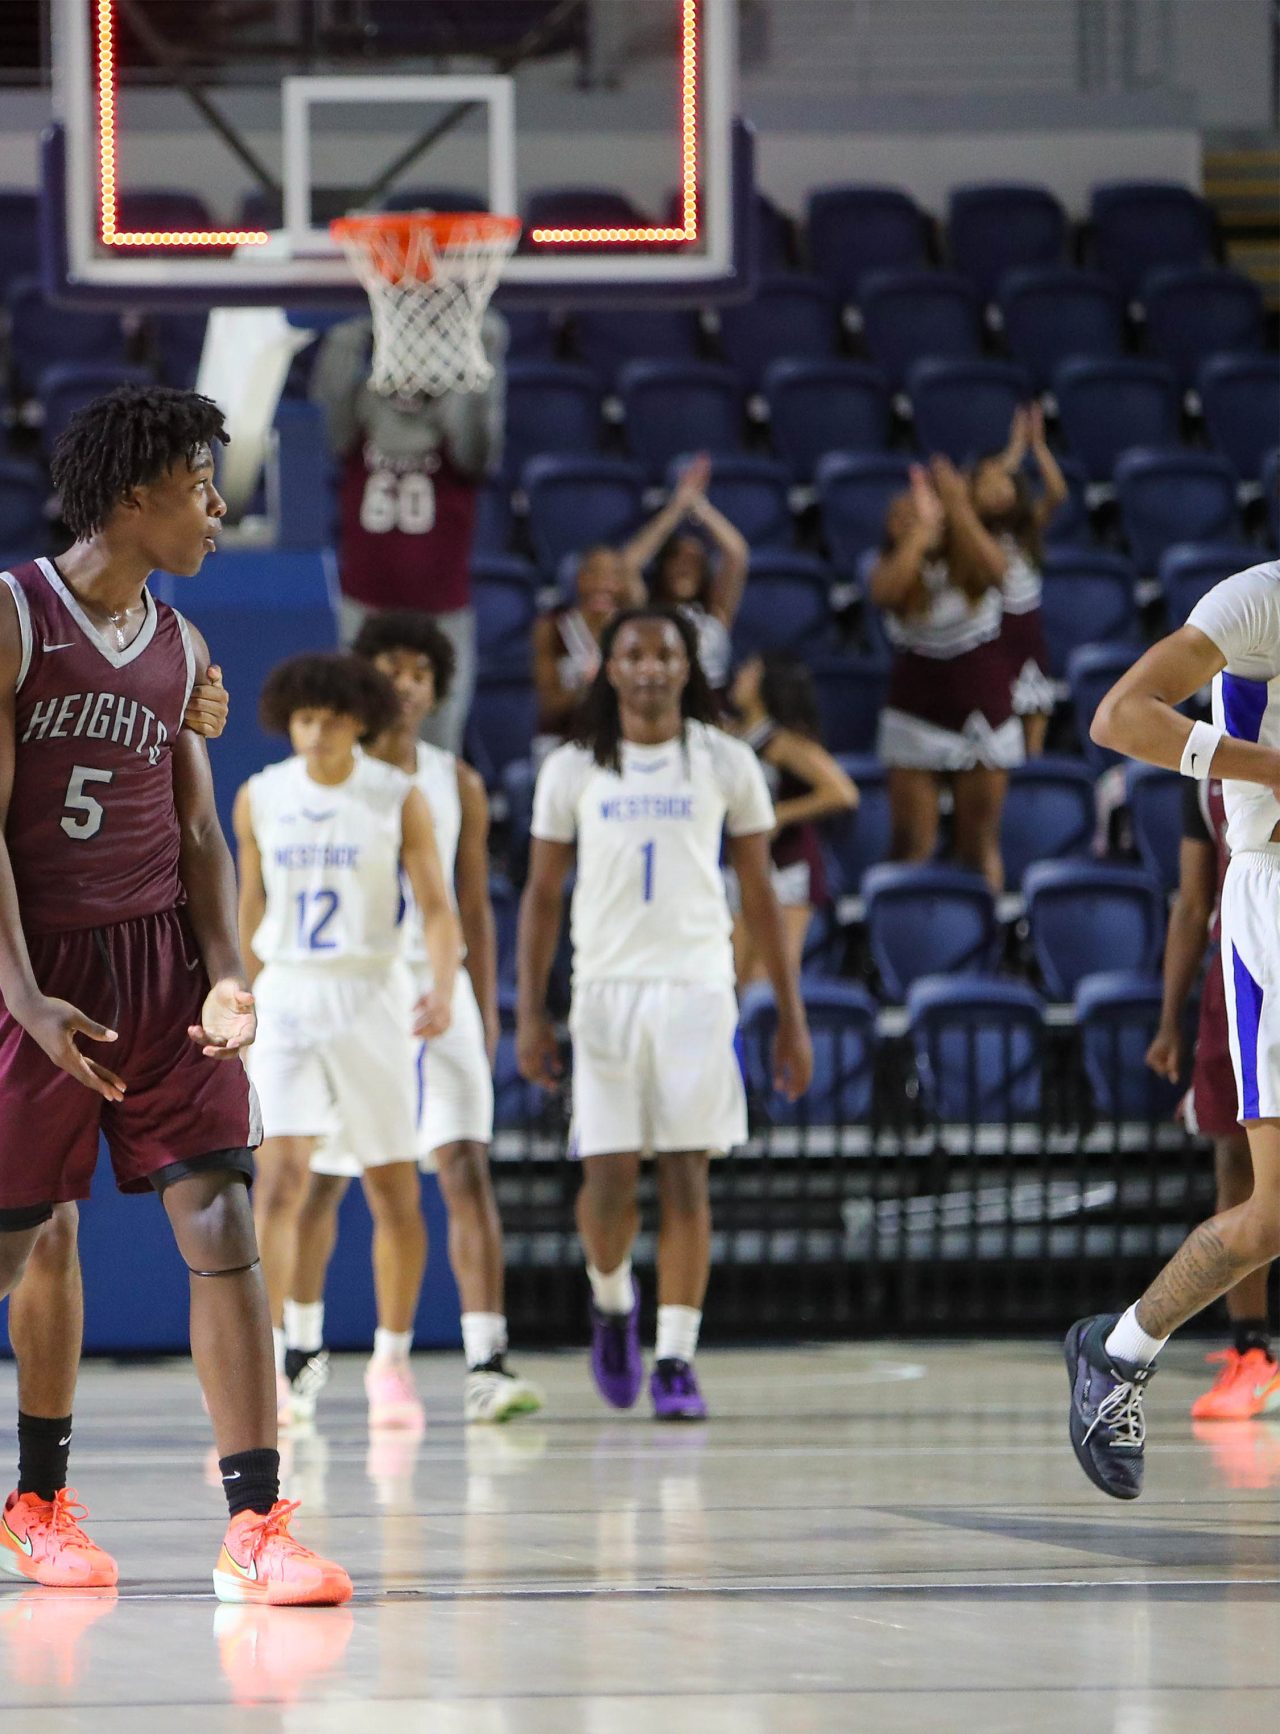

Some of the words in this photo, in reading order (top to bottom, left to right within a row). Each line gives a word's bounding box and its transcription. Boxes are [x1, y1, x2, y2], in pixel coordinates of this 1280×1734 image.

[22, 692, 167, 765] HEIGHTS
[60, 765, 113, 840] 5
[640, 840, 656, 903] 1
[297, 890, 339, 949] 12
